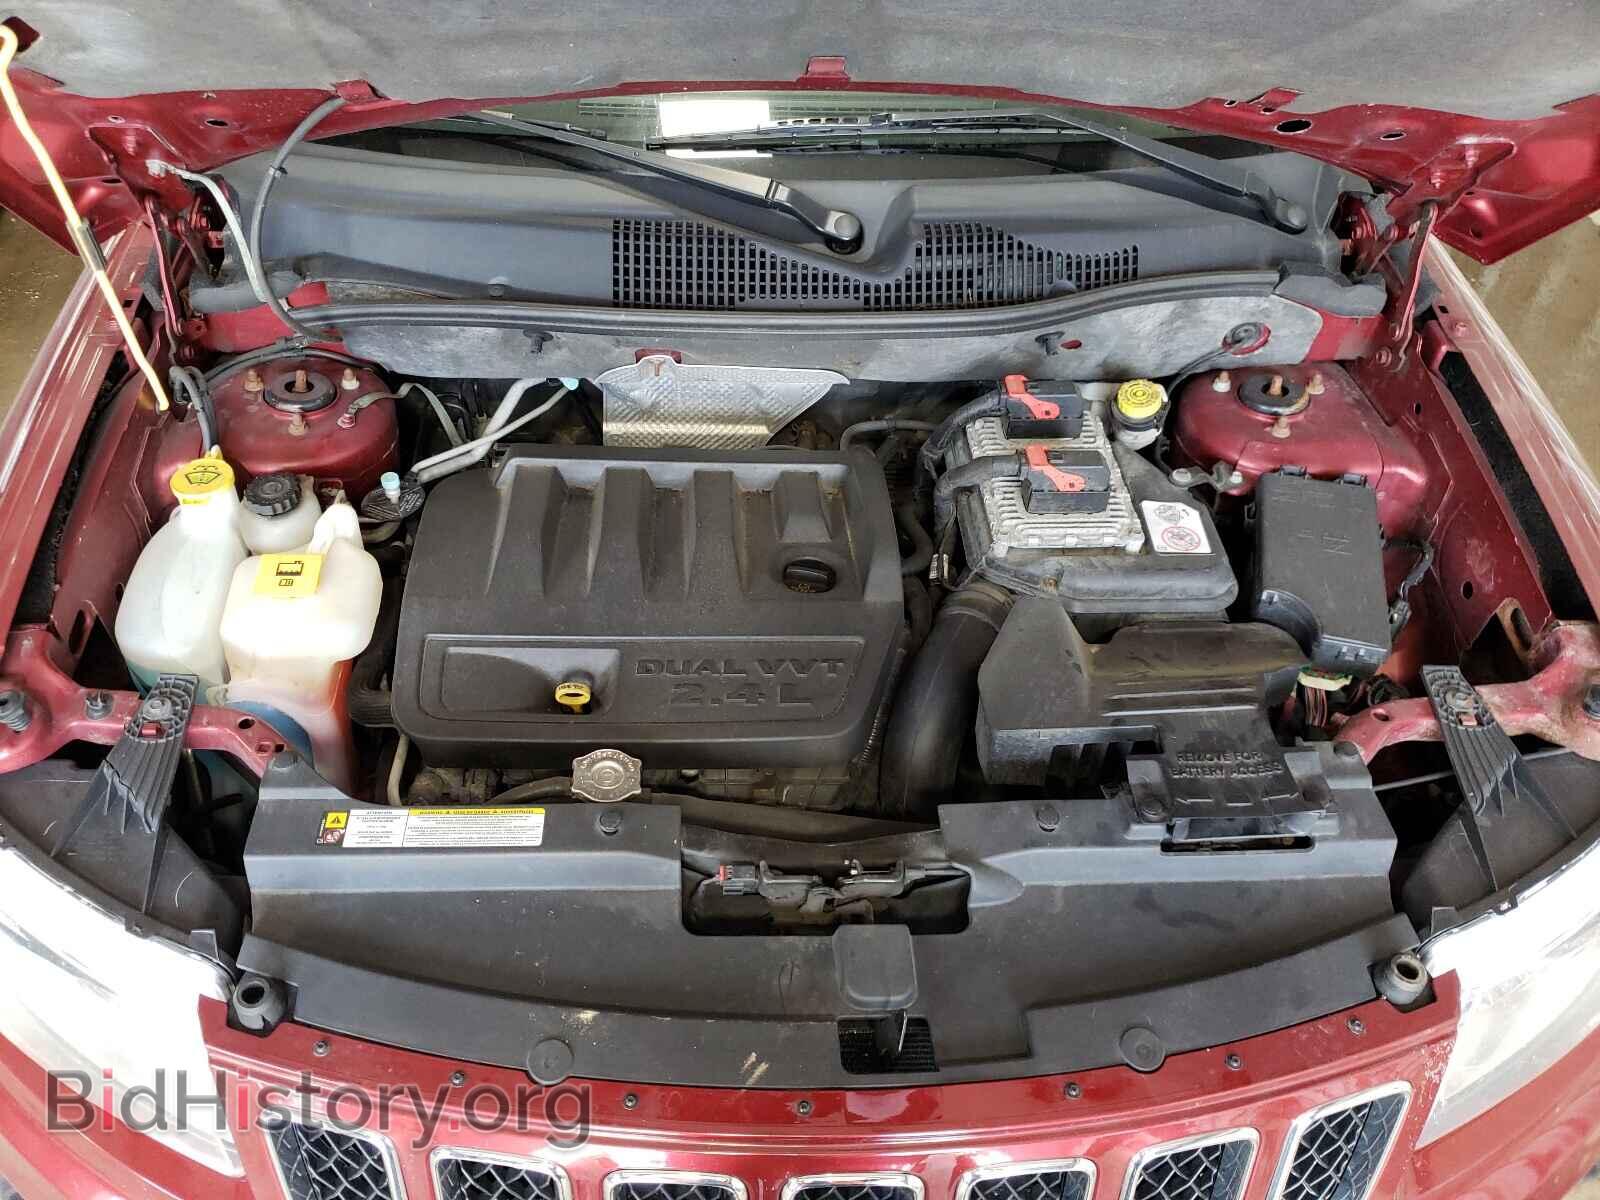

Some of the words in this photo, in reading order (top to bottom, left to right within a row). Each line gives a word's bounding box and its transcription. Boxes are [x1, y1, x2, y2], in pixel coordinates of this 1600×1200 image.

[635, 658, 747, 677] DUAL
[754, 657, 848, 677] VVT
[1176, 751, 1233, 765] REMOVE
[1233, 751, 1264, 763] FOR
[1169, 766, 1225, 779] BATTERY
[1230, 761, 1284, 778] ACCESS
